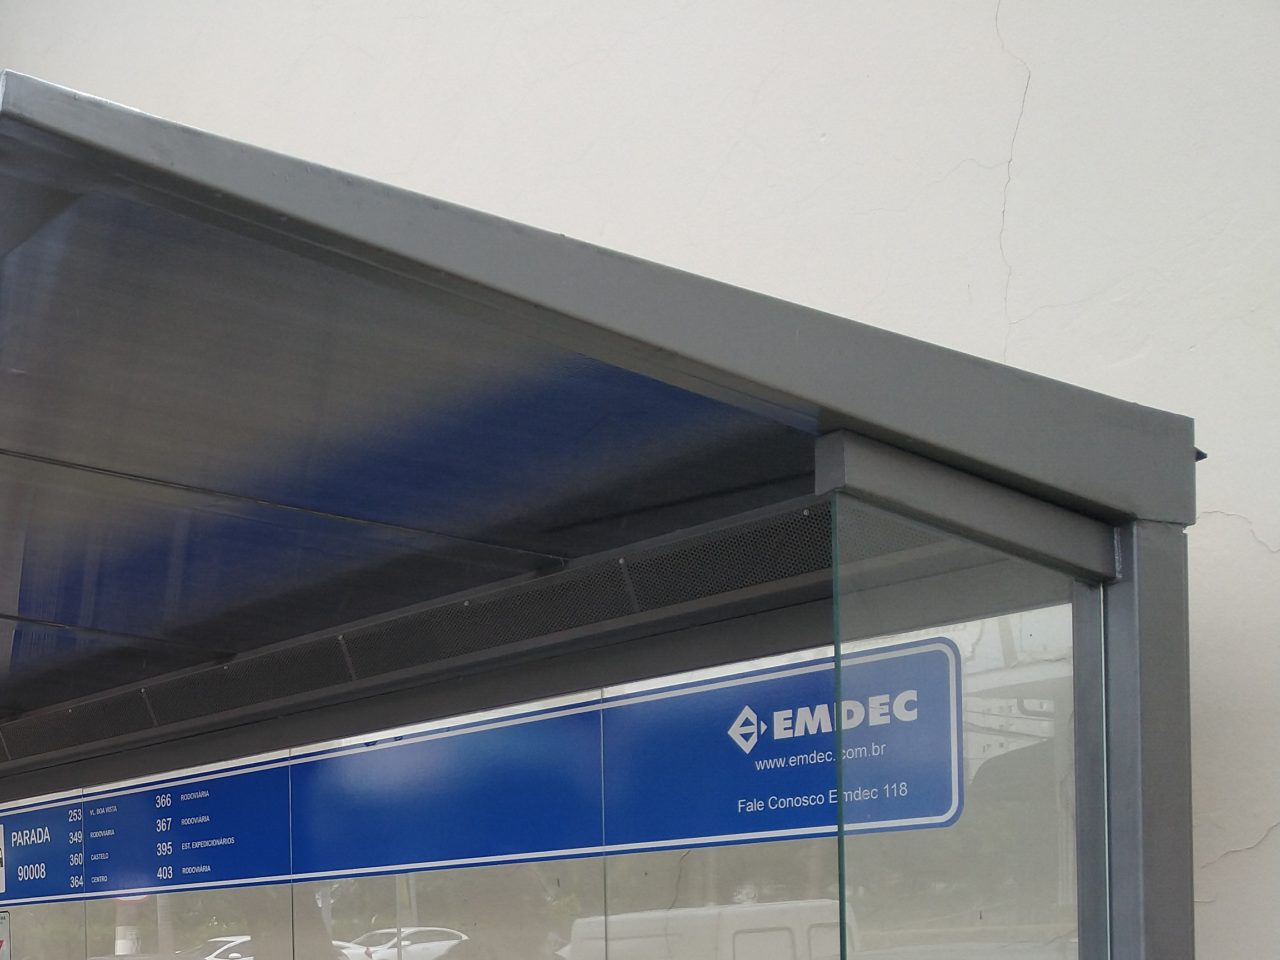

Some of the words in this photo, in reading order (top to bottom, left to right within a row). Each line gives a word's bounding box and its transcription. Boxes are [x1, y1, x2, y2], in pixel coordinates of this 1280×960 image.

[774, 690, 918, 740] EMDEC
[156, 794, 172, 808] 366
[738, 799, 765, 814] Fale
[768, 792, 825, 810] Conosco
[829, 787, 879, 804] Emdec
[883, 782, 908, 798] 118
[68, 808, 82, 822] 253
[156, 818, 172, 832] 367
[11, 826, 51, 848] PARADA
[68, 831, 82, 844] 349
[156, 842, 172, 856] 395
[70, 853, 83, 866] 360
[91, 852, 109, 861] CASTELO
[18, 863, 46, 881] 90008
[156, 866, 173, 879] 403
[70, 876, 84, 888] 364
